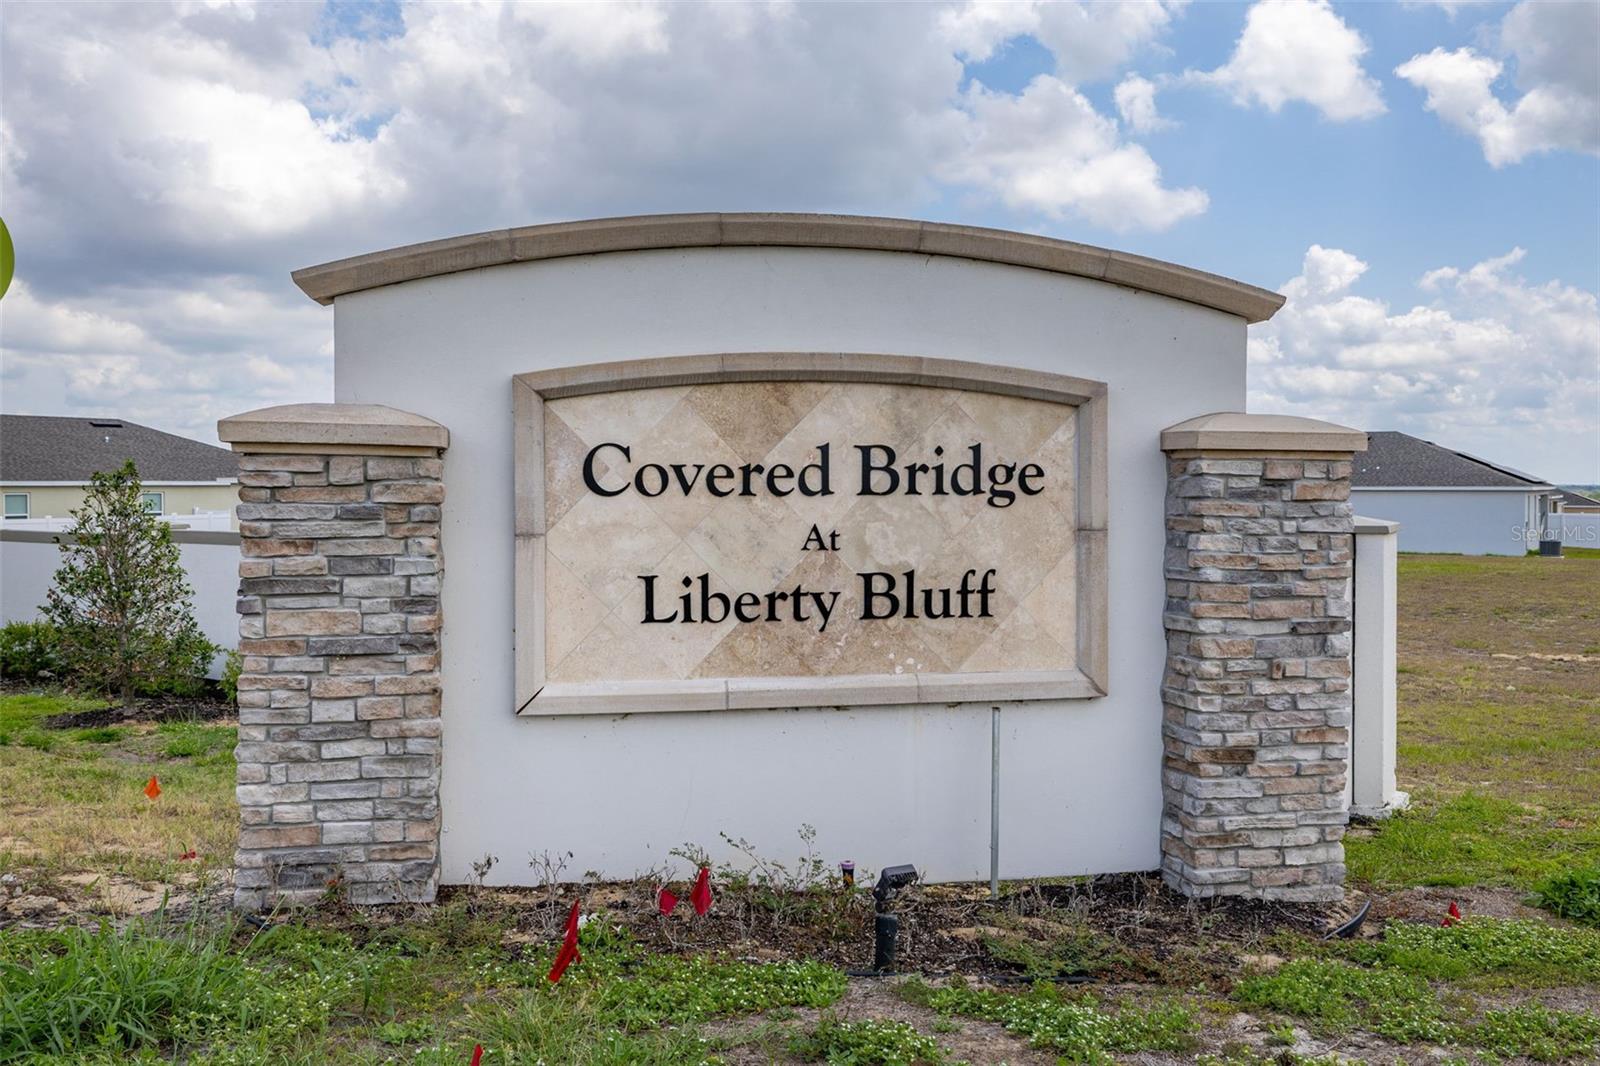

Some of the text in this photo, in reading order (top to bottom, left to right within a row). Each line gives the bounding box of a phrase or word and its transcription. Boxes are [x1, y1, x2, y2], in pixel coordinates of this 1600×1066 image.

[582, 442, 1046, 509] Covered Bridge
[800, 523, 841, 552] At
[637, 568, 997, 633] Liberty Bluff
